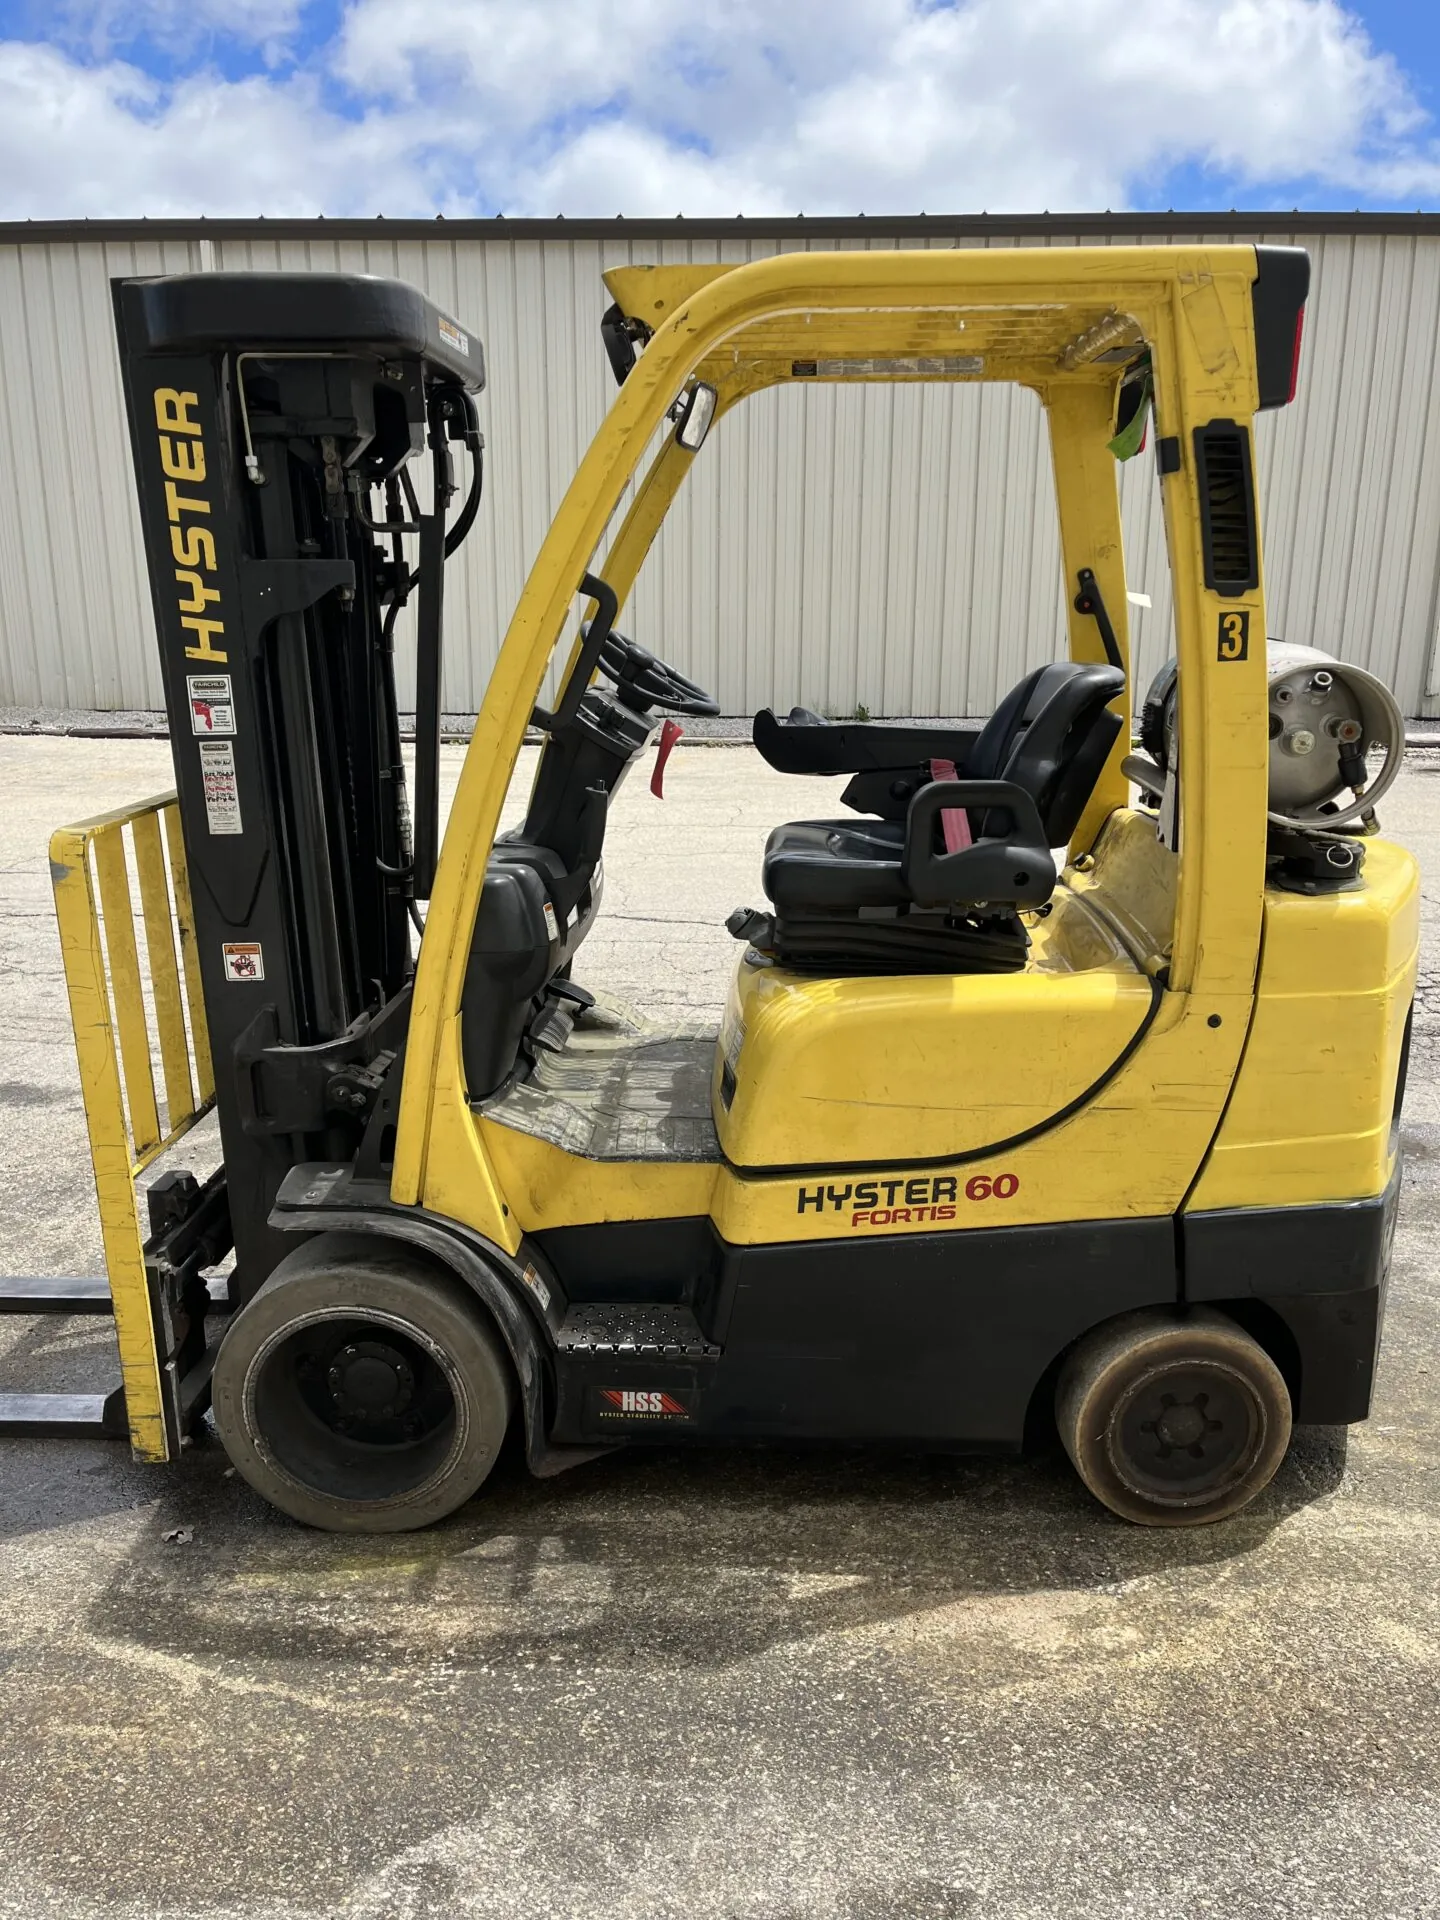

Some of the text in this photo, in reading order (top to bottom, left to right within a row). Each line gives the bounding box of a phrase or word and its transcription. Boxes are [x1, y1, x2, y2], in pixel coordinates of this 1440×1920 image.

[153, 387, 227, 662] HYSTER
[1220, 613, 1243, 659] 3
[797, 1173, 1019, 1213] HYSTER 60
[851, 1205, 956, 1227] FORTIS
[622, 1391, 663, 1412] HSS
